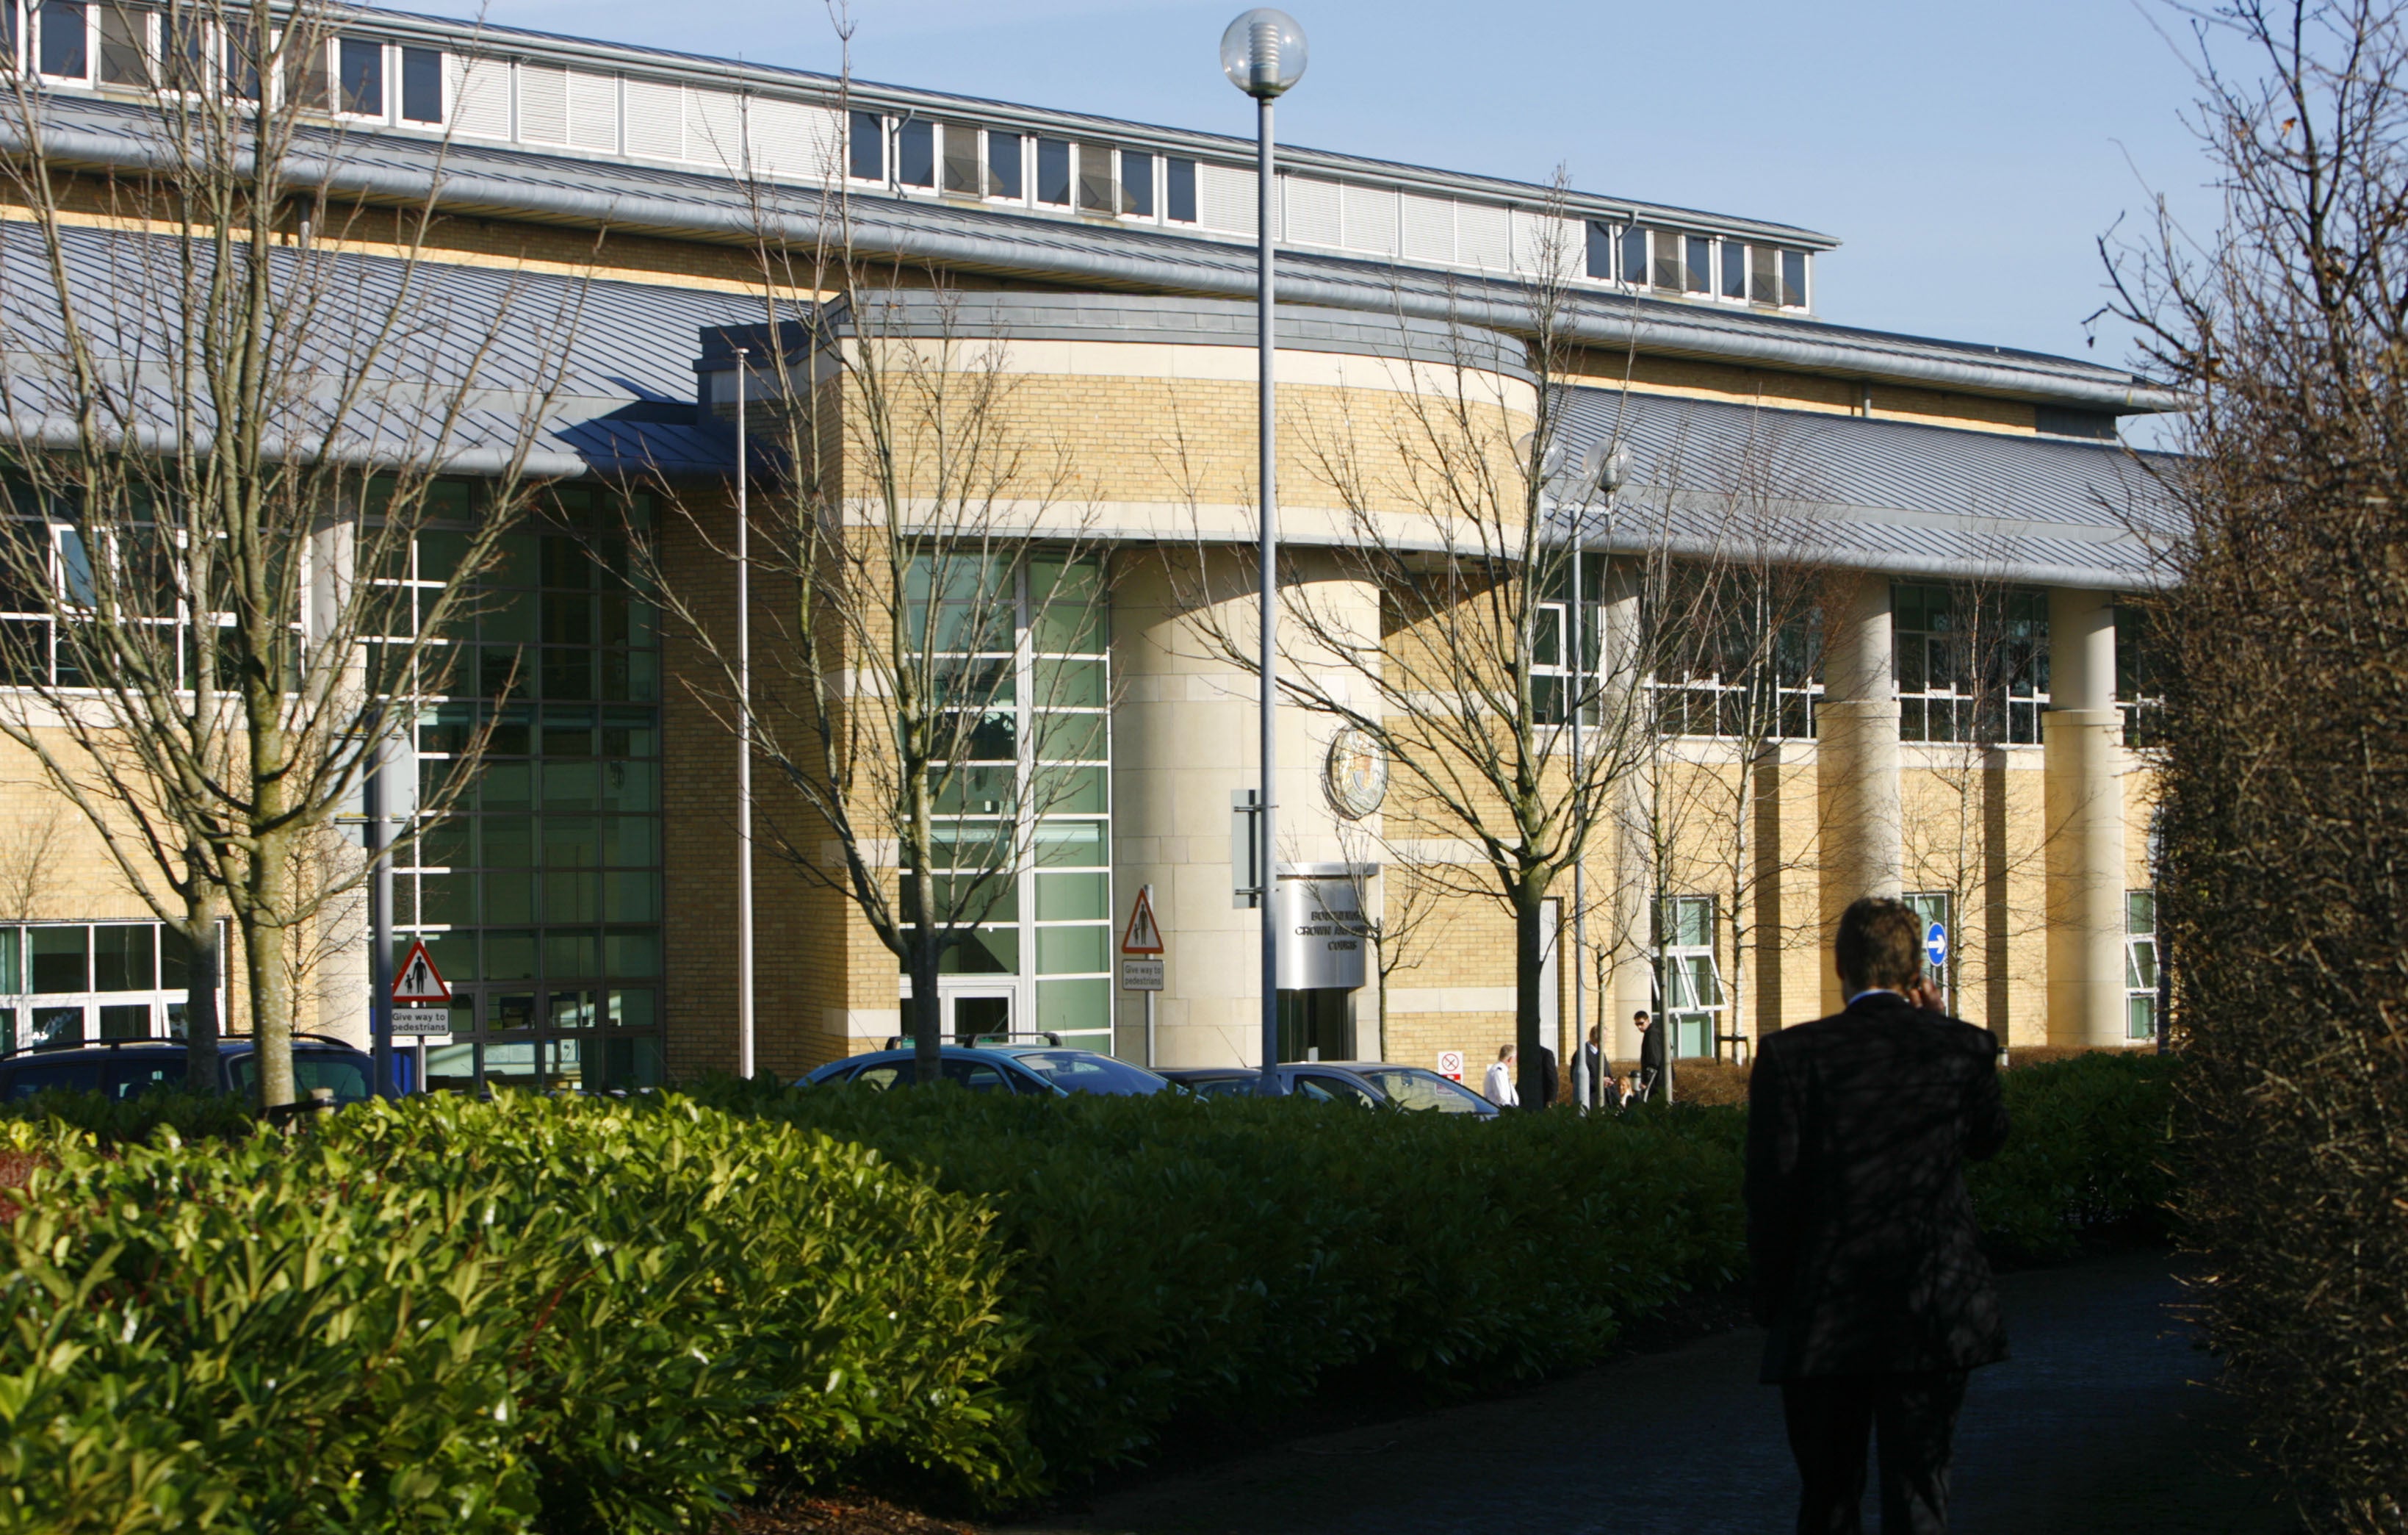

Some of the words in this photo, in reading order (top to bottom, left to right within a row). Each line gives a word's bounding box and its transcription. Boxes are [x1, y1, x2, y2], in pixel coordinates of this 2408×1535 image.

[1295, 926, 1331, 935] CROWN
[1125, 965, 1139, 974] Give
[1140, 968, 1153, 976] way
[1125, 977, 1161, 985] pedestrians
[392, 1013, 412, 1021] Give
[415, 1014, 433, 1022] way
[392, 1023, 445, 1032] pedestrians
